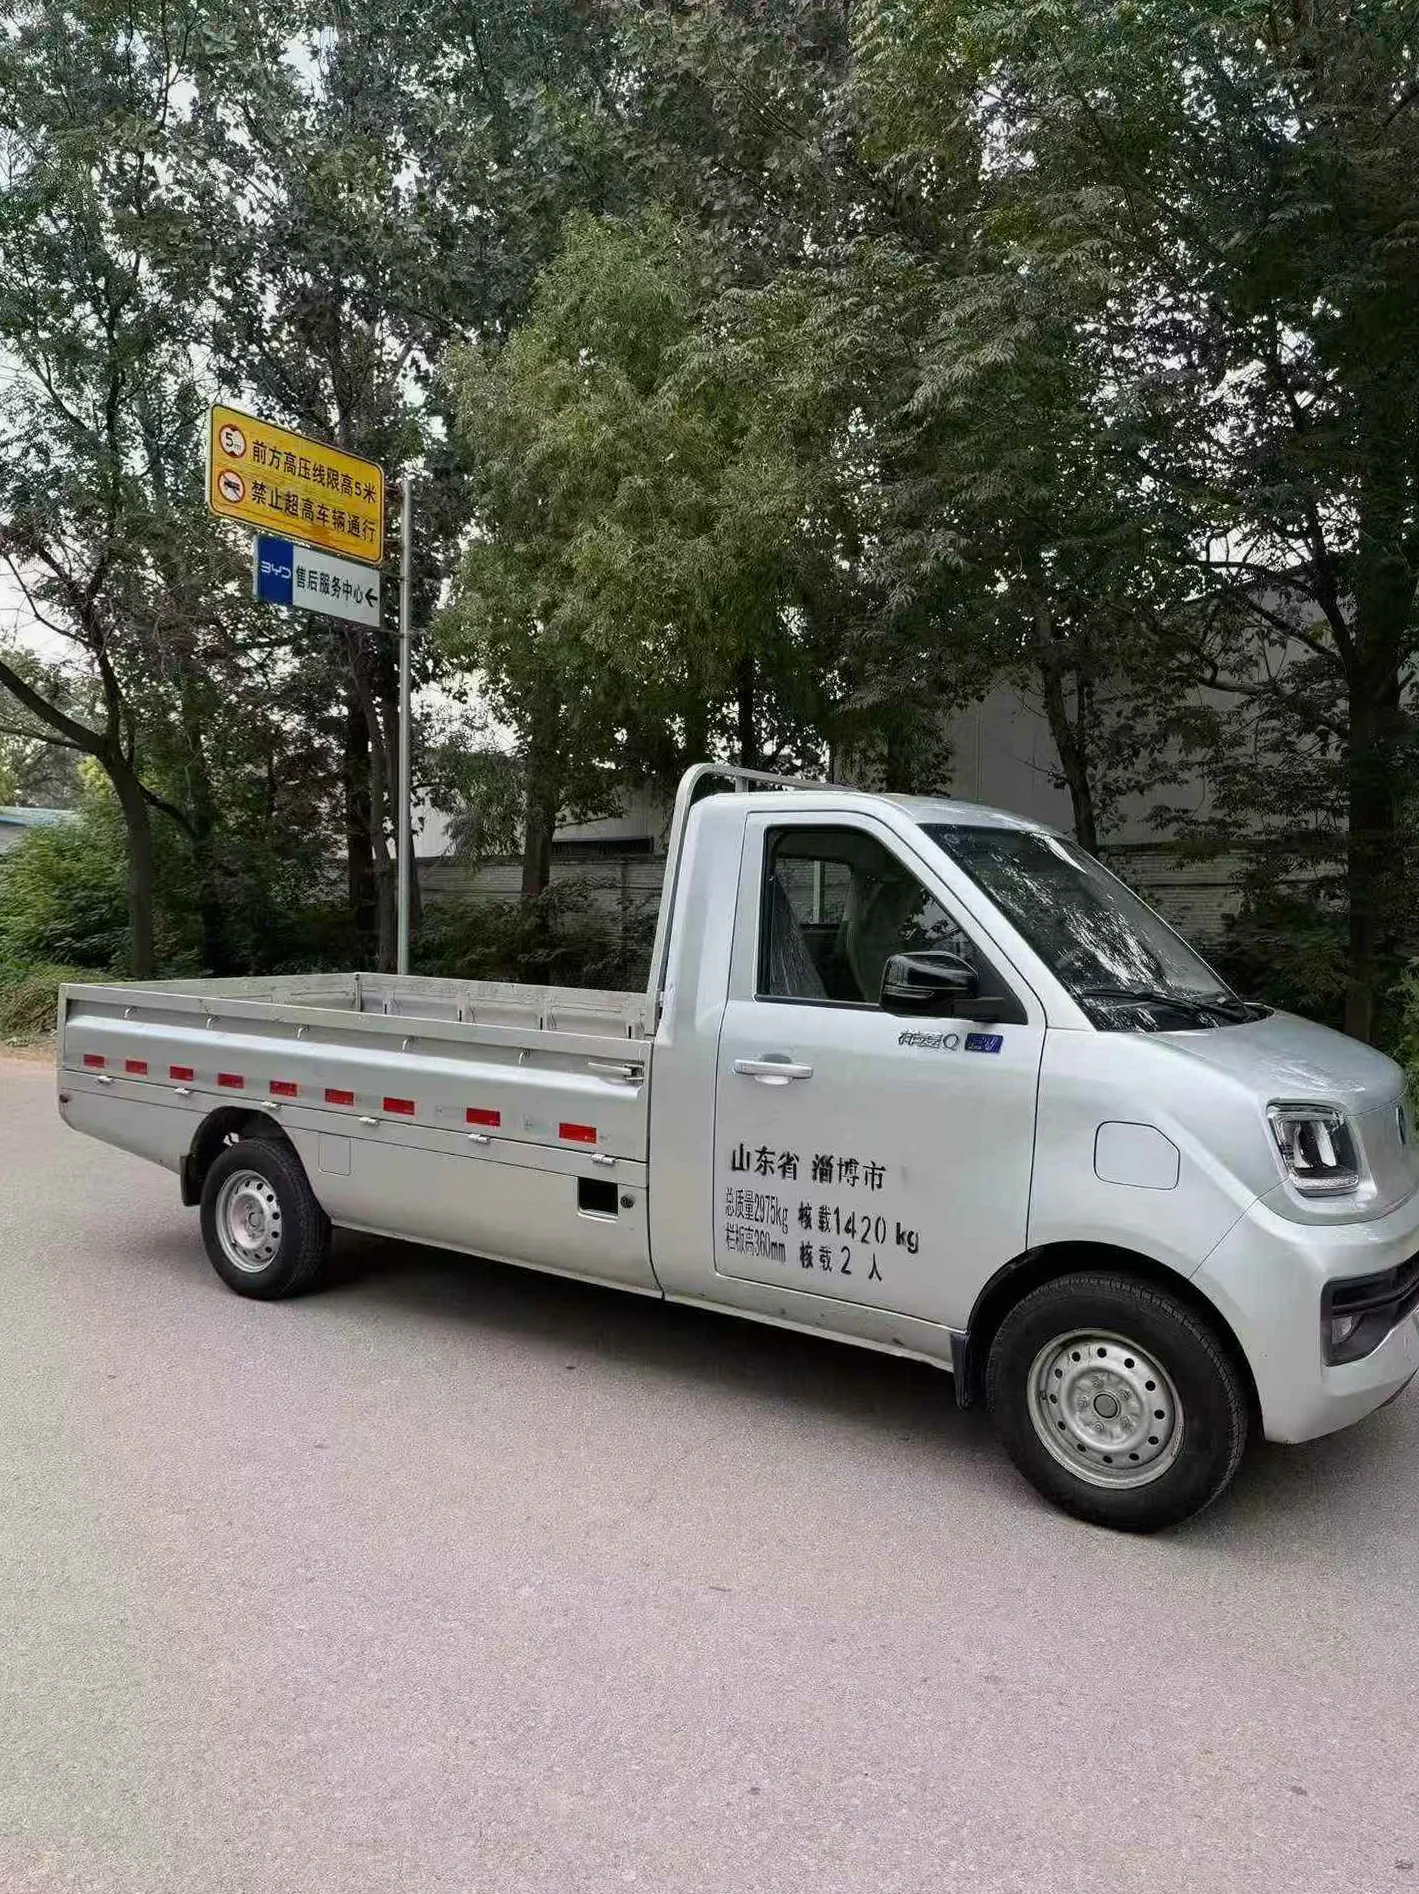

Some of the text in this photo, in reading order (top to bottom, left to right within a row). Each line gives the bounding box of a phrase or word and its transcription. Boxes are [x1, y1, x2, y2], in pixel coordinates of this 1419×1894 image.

[252, 440, 376, 504] 前方高压线限高5米
[251, 480, 376, 543] 禁止超高车辆通行
[260, 560, 292, 579] BYD
[296, 563, 364, 604] 售后服务中心
[731, 1143, 886, 1191] 山东省 淄博市
[725, 1187, 788, 1234] 总质量2975kg
